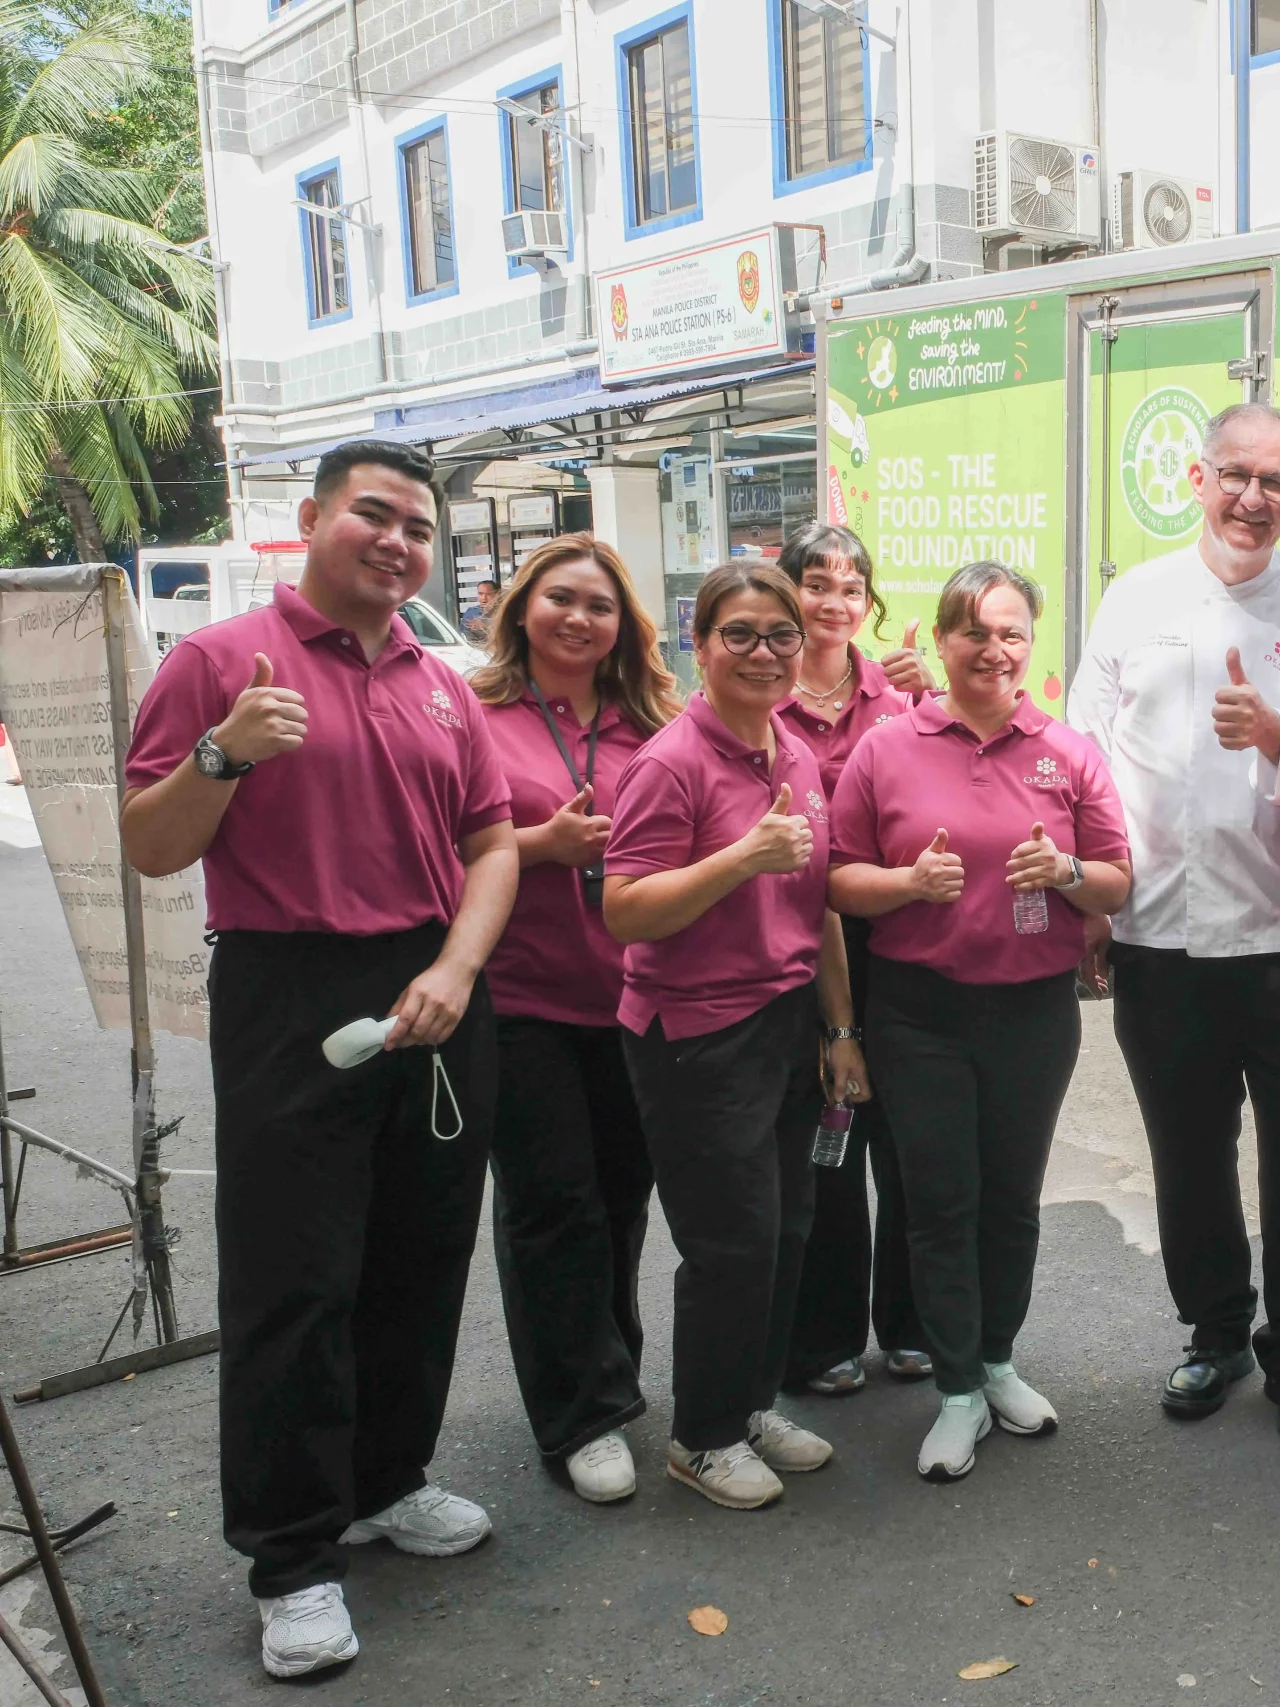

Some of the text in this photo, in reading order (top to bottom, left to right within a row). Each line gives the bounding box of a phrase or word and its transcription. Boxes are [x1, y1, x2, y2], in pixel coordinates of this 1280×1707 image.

[1080, 167, 1097, 176] GREE
[1198, 191, 1210, 199] TCL
[653, 304, 674, 318] MANILA
[674, 299, 693, 314] POLICE
[694, 293, 717, 308] DISTRICT
[632, 325, 643, 342] STA
[644, 323, 660, 340] ANA
[660, 318, 682, 337] POLICE
[683, 312, 712, 332] STATION
[716, 308, 733, 325] PS-6
[733, 326, 765, 341] SAMARAH
[908, 307, 1007, 340] feeding the MIND,
[921, 337, 980, 365] saving the
[908, 360, 1006, 391] ENVIRONMENT!
[1128, 400, 1158, 451] SCHOLARS
[1160, 396, 1170, 407] OF
[878, 456, 924, 491] SOS
[947, 453, 996, 488] THE
[877, 492, 1047, 529] FOOD RESCUE
[1129, 489, 1164, 531] FEEDING
[1168, 515, 1186, 532] THE
[877, 534, 1035, 569] FOUNDATION
[423, 704, 463, 728] OKADA
[1023, 775, 1069, 785] OKADA
